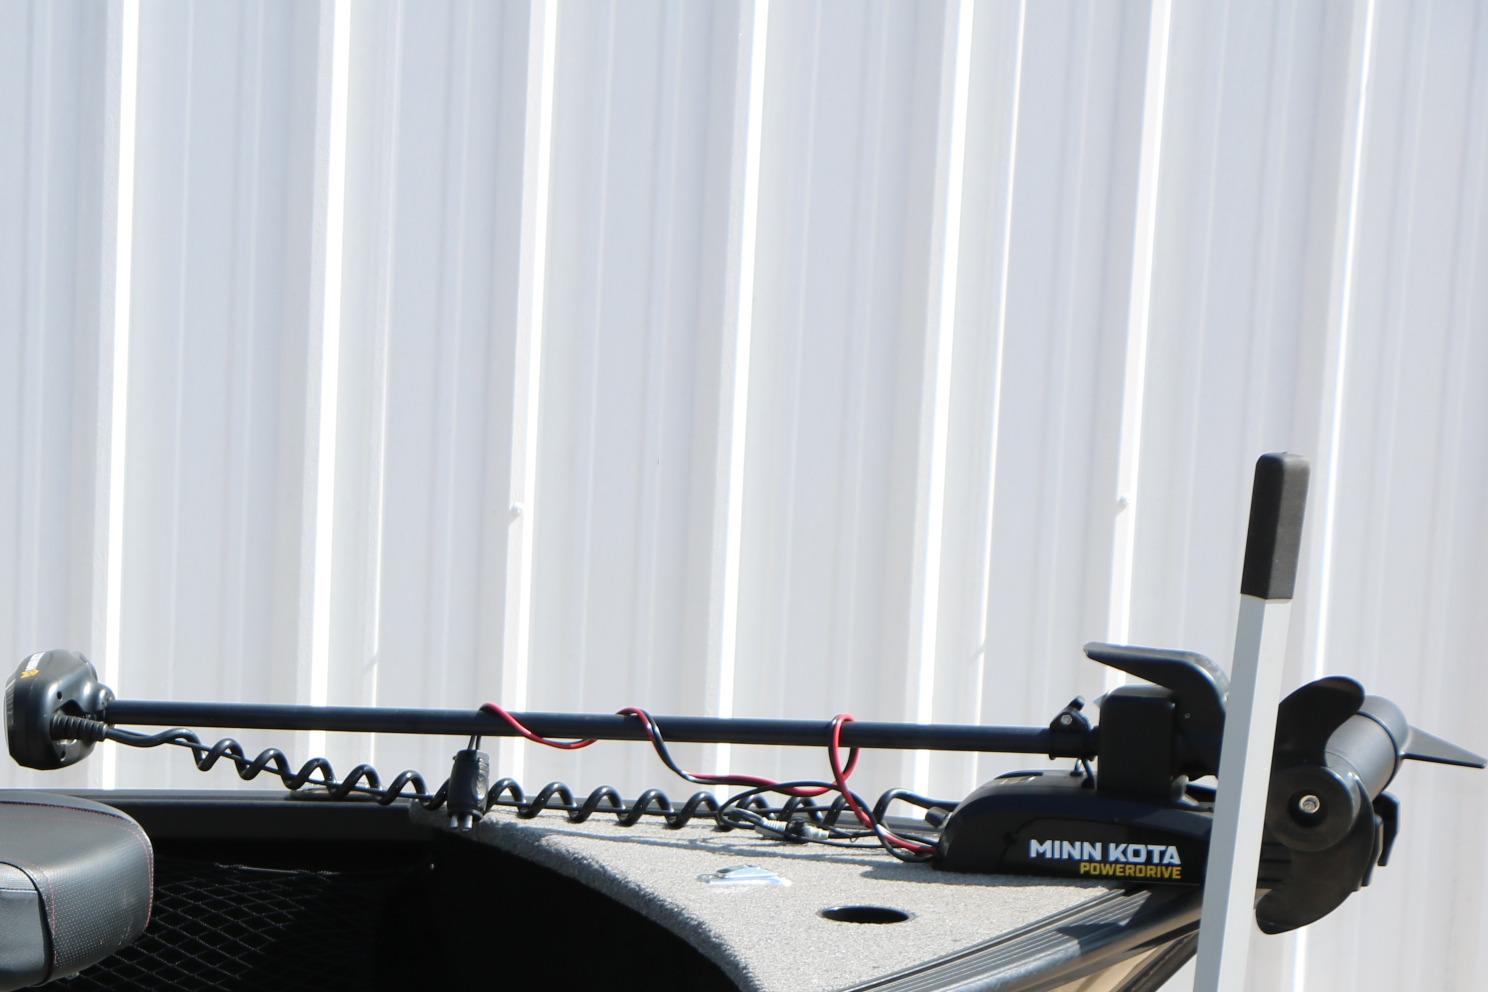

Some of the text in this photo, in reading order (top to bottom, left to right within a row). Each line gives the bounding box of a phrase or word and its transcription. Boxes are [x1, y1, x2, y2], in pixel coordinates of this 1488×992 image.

[1029, 839, 1181, 865] MINN KOTA
[1079, 862, 1182, 880] POWERDRIVE
